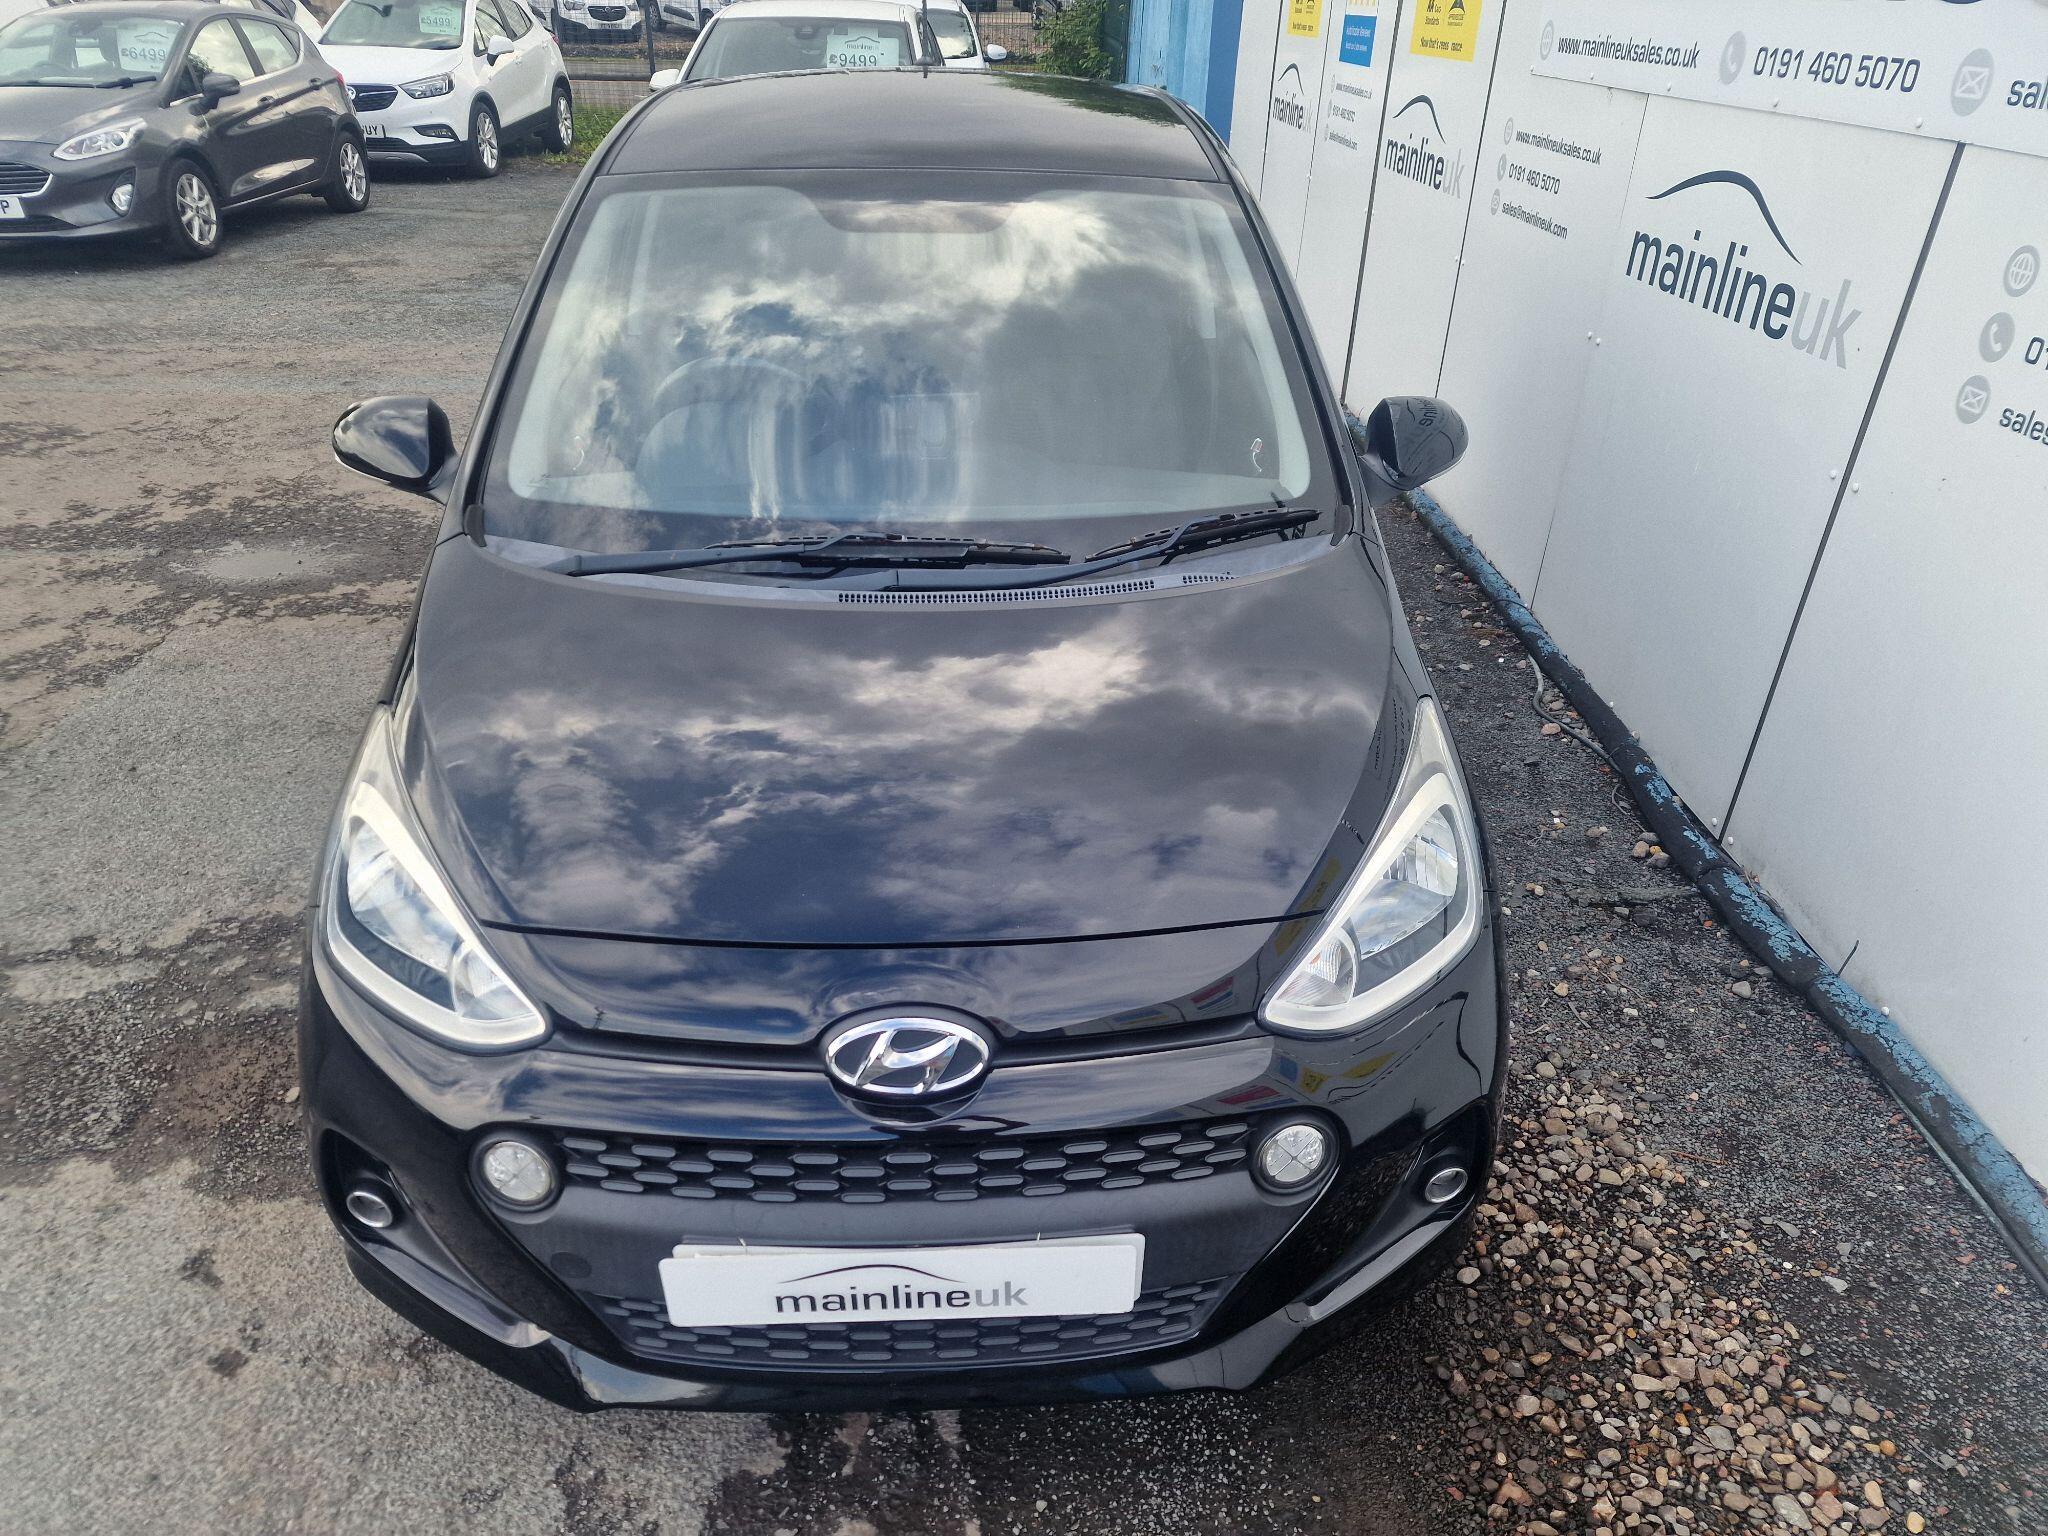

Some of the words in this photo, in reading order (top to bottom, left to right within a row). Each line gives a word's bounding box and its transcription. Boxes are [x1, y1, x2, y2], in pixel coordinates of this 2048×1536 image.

[121, 47, 166, 61] £6499
[829, 53, 878, 67] £9499
[1557, 34, 1700, 69] www.mainlineuksales.co.uk
[1753, 46, 1804, 79] 0191
[1807, 51, 1853, 85] 460
[1854, 54, 1921, 93] 5070
[363, 125, 378, 135] UY
[1515, 129, 1602, 165] www.mainlineuksales.co.uk
[1384, 133, 1465, 199] mainlineuk
[1509, 163, 1526, 183] 0191
[1526, 171, 1540, 188] 460
[1540, 175, 1561, 194] 5070
[1501, 200, 1568, 239] sales@mainlineuk.com
[1626, 230, 1862, 370] mainlineuk
[776, 1281, 1028, 1313] mainlineuk
